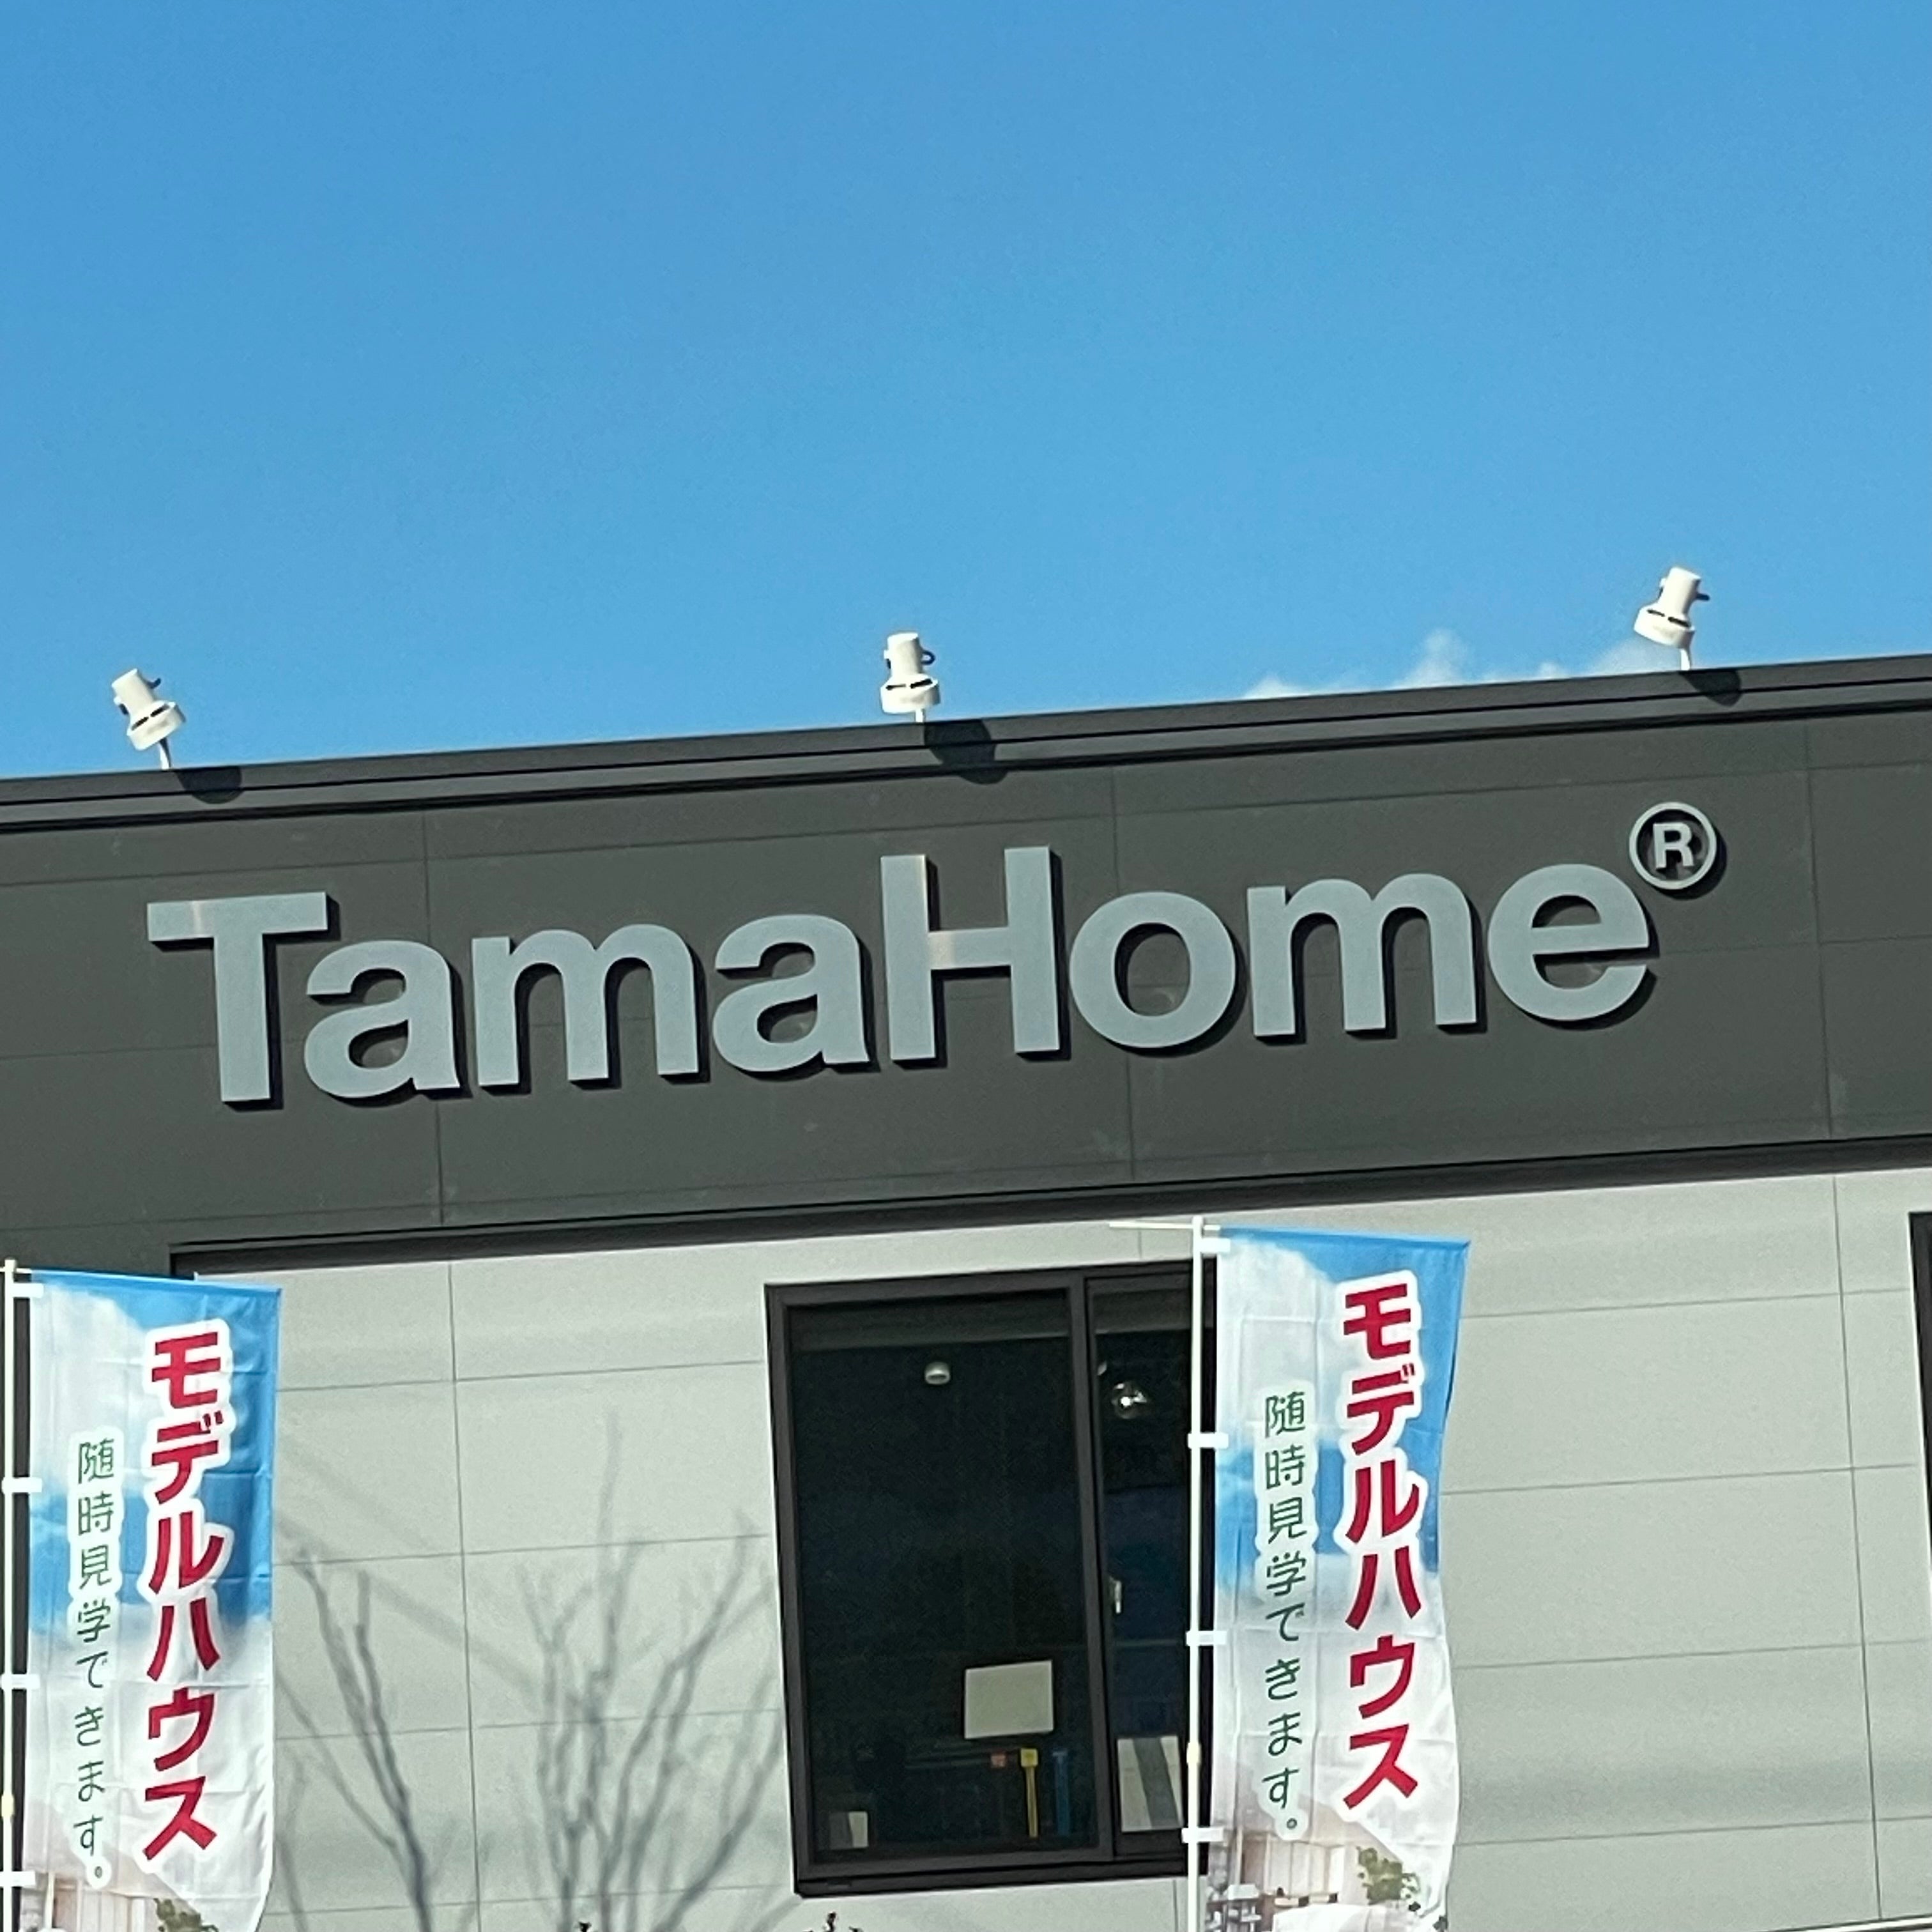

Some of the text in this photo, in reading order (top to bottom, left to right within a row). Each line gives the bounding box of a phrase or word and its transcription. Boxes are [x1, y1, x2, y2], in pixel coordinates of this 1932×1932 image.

[73, 1438, 114, 1879] 随時見学できます。
[144, 1330, 225, 1860] モデルハウス
[1262, 1390, 1307, 1830] 随時見学できます。
[1343, 1282, 1420, 1809] モデルハウス
